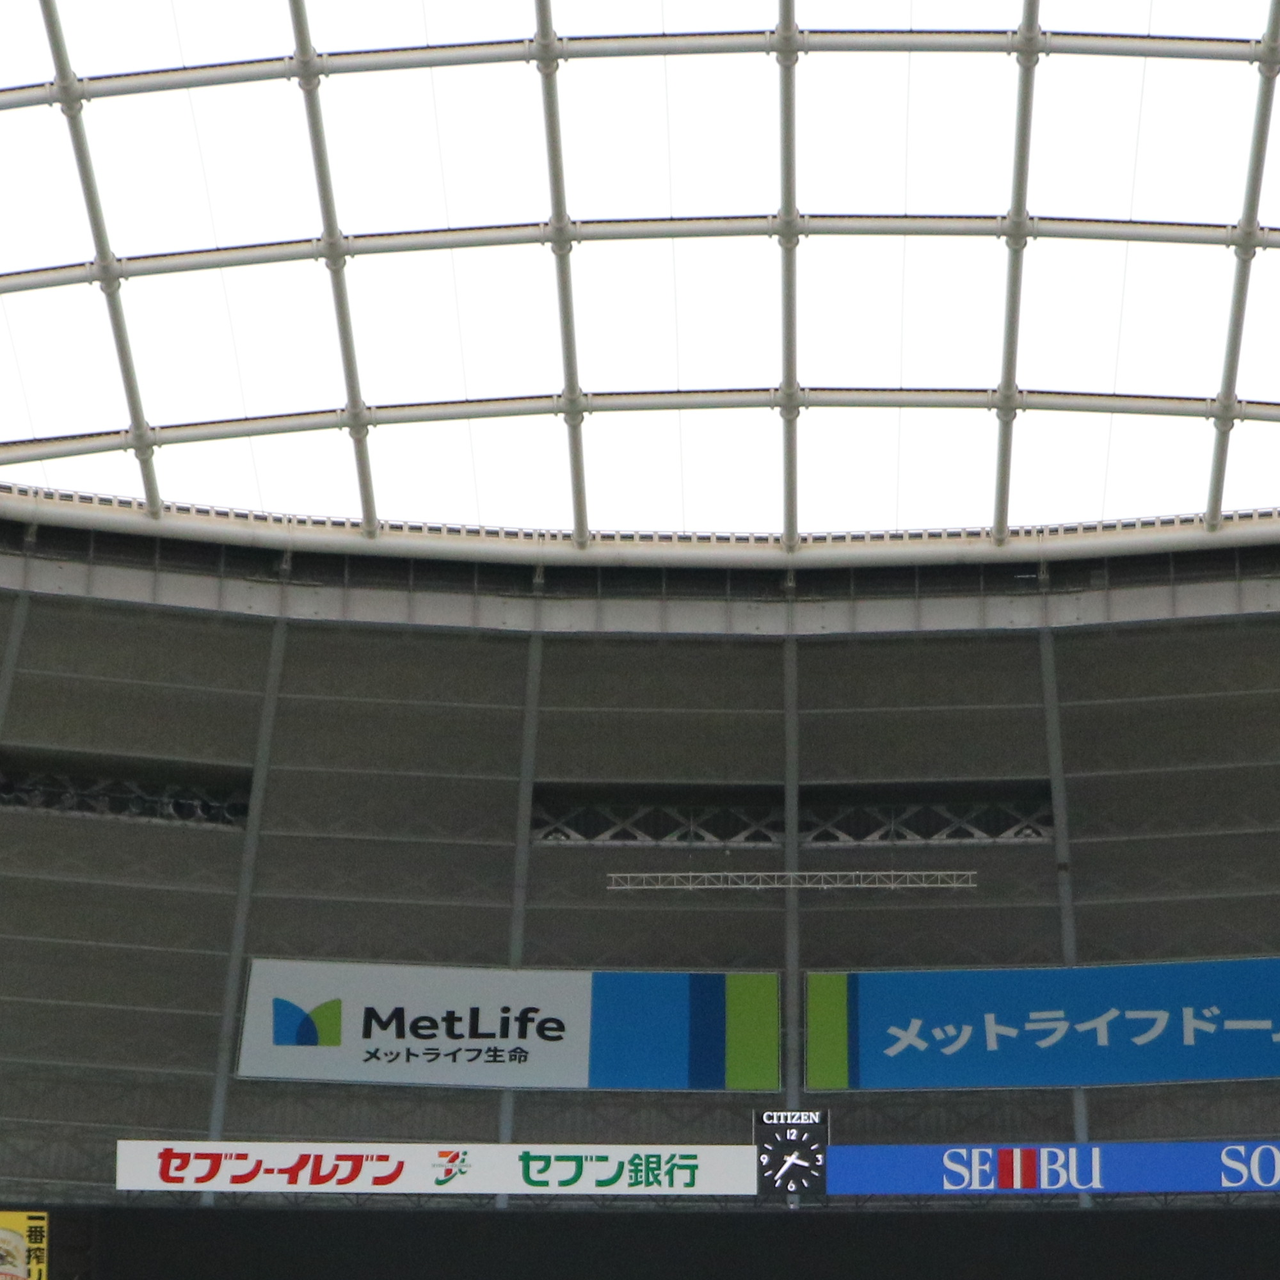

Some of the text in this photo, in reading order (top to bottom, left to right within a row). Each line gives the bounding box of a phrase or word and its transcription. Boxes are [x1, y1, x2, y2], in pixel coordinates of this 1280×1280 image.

[362, 1006, 566, 1042] MetLife
[362, 1047, 529, 1064] メットライフ生命
[762, 1111, 820, 1124] CITIZEN
[786, 1128, 797, 1140] 12
[760, 1154, 768, 1165] 9
[815, 1154, 823, 1165] 3
[518, 1151, 699, 1188] セブン銀行
[942, 1147, 1104, 1190] SEIBU
[787, 1179, 796, 1192] 6
